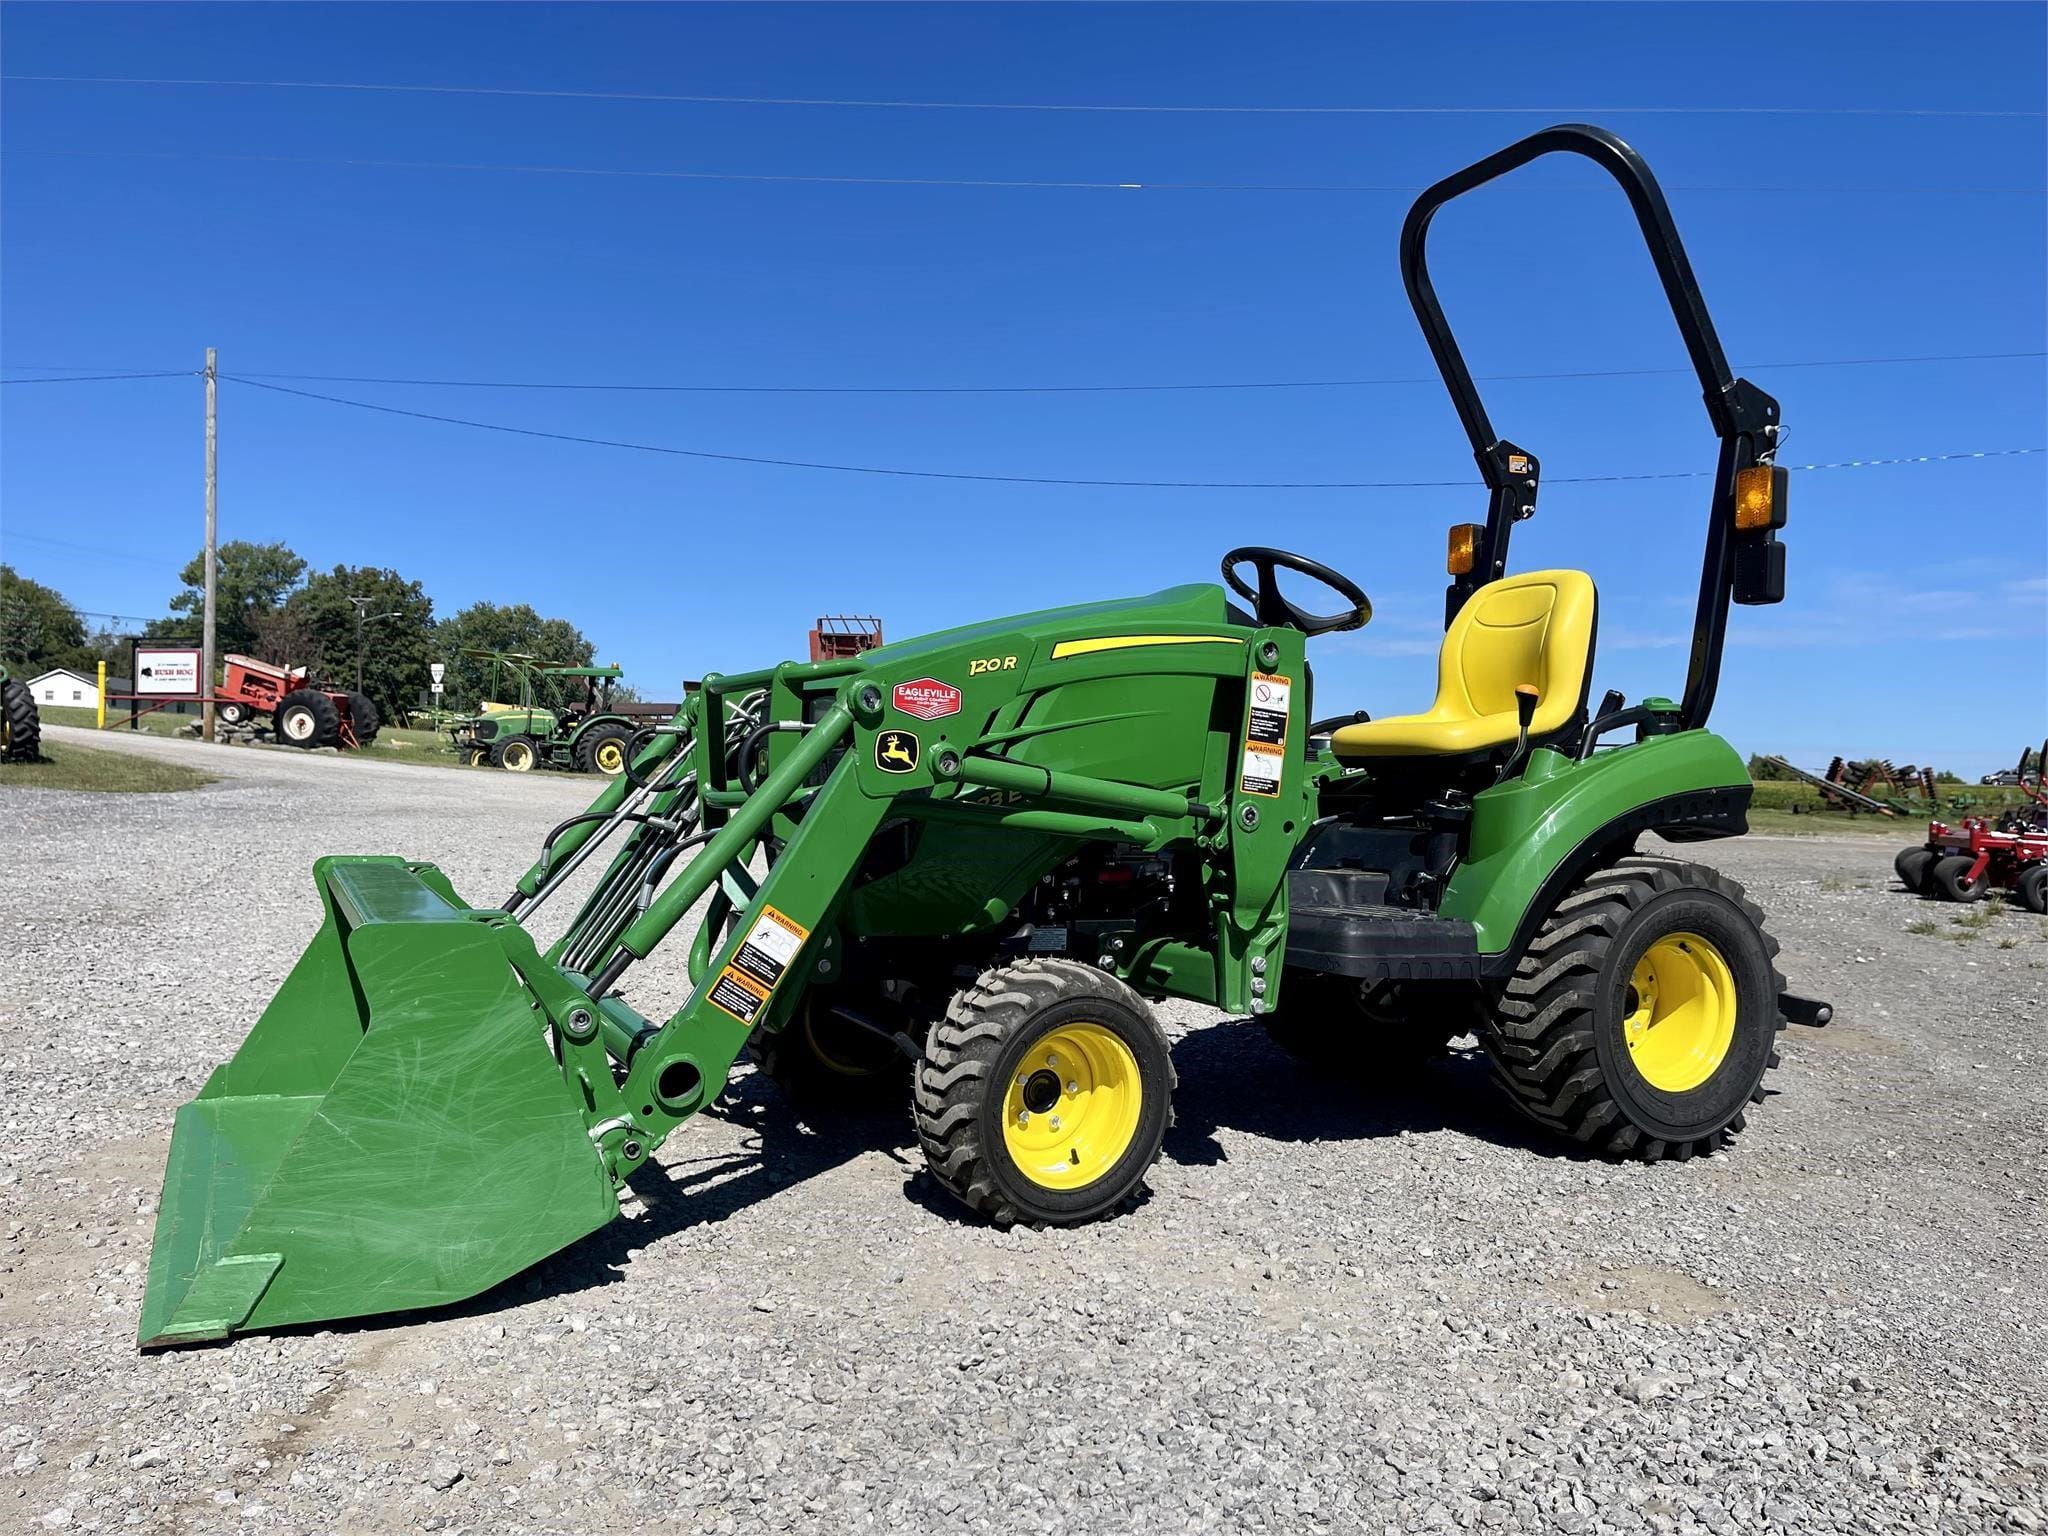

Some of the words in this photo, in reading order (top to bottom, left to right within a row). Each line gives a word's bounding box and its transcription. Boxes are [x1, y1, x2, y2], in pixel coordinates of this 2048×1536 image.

[1259, 674, 1289, 685] WARNING
[898, 687, 957, 699] EAGLEVILLE
[1252, 745, 1283, 756] WARNING
[774, 914, 803, 936] WARNING
[735, 975, 764, 997] WARNING
